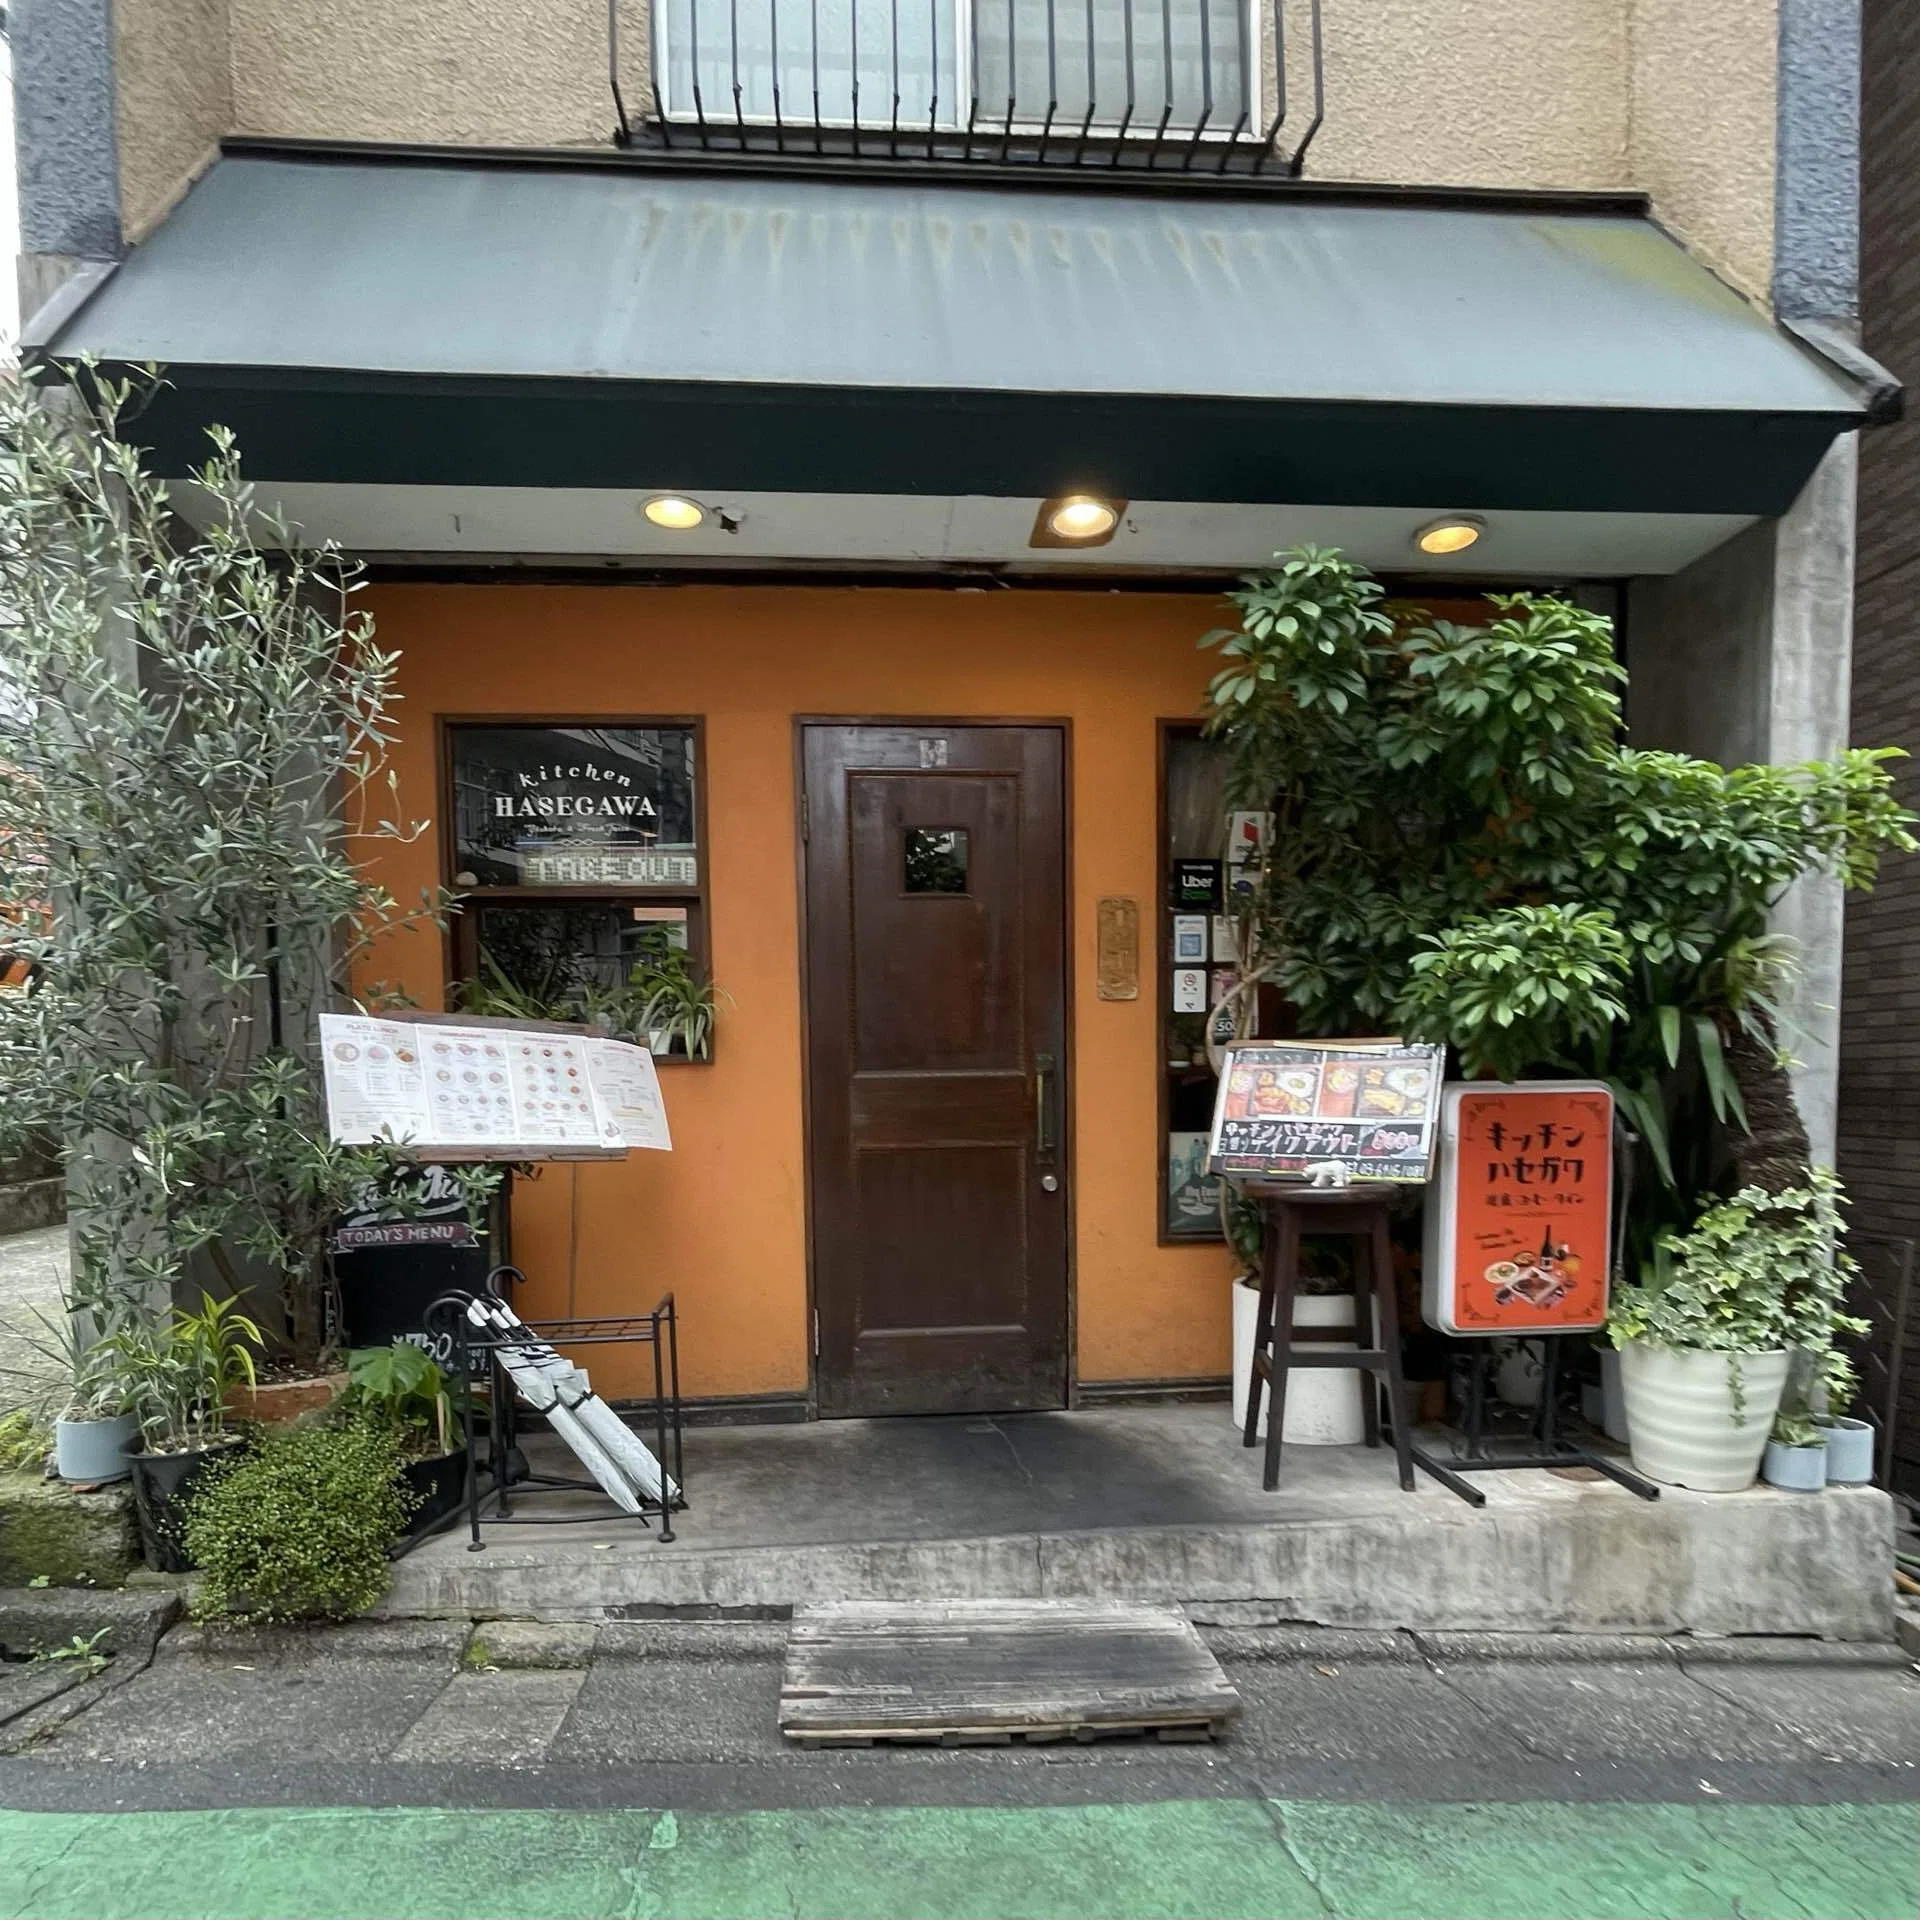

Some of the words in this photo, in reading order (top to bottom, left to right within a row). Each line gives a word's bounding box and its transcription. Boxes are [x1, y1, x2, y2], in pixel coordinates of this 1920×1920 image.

[519, 763, 631, 787] kitchen
[495, 796, 656, 817] HASEGAWA
[528, 857, 622, 882] TAKE
[628, 857, 697, 882] OUT
[1182, 875, 1214, 888] Uber
[1486, 1122, 1585, 1151] キッチン
[1488, 1156, 1584, 1184] ハセガワ
[344, 1229, 402, 1243] TODAY'S
[408, 1225, 454, 1240] MENU
